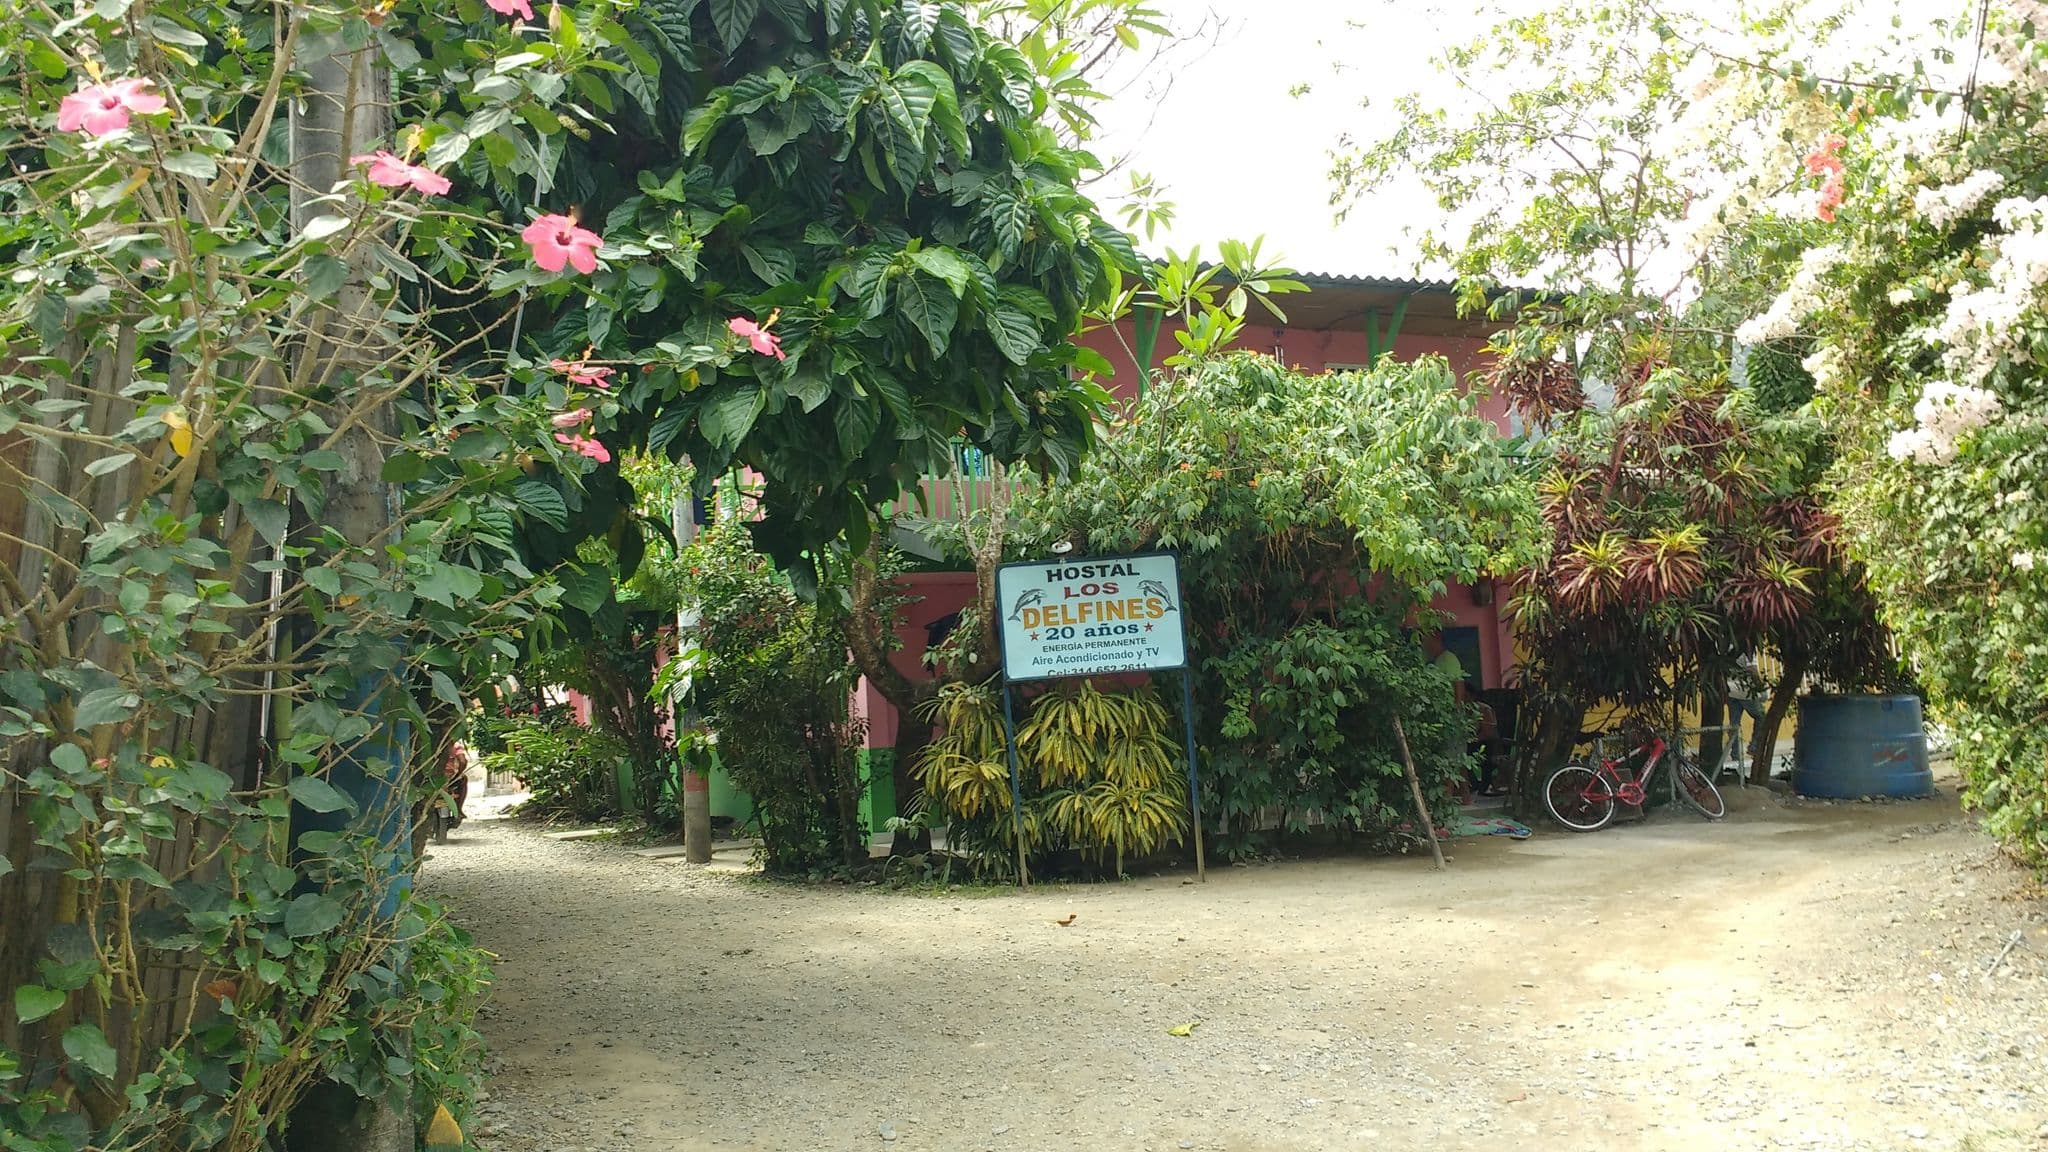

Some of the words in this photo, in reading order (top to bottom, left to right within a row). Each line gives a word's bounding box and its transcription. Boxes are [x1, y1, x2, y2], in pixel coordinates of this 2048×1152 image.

[1046, 564, 1140, 582] HOSTAL
[1064, 582, 1119, 599] LOS
[1022, 598, 1165, 630] DELFINES
[1046, 626, 1075, 640] 20
[1085, 623, 1138, 637] años
[1085, 638, 1147, 649] PERMANENTE
[1032, 656, 1054, 666] Aire
[1056, 649, 1135, 664] Acondicionado
[1137, 651, 1143, 661] y
[1145, 647, 1160, 657] TV
